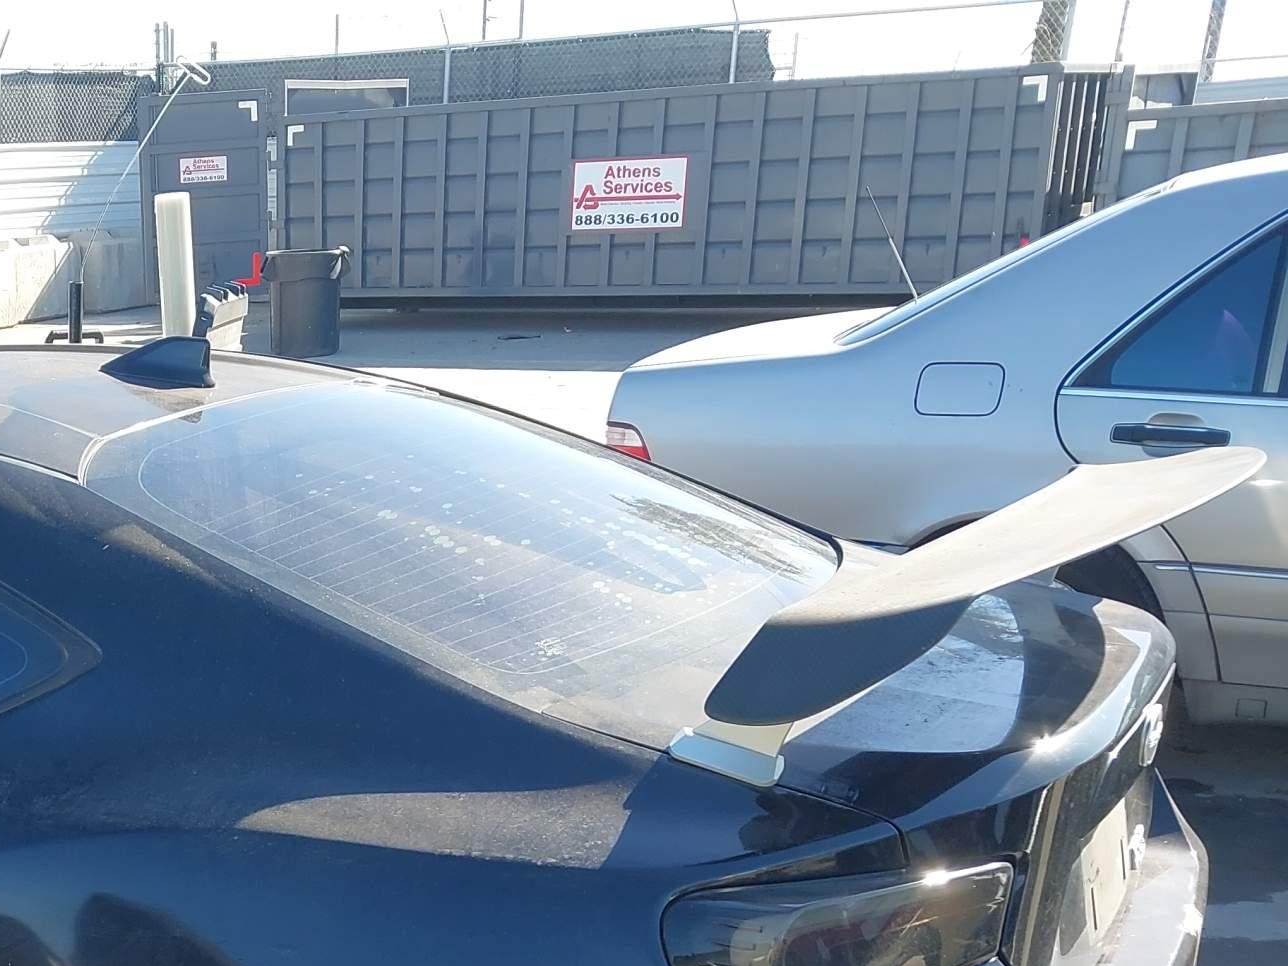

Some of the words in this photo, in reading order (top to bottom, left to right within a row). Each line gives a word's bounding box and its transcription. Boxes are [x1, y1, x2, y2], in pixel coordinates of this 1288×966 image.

[604, 165, 661, 179] Athens
[603, 179, 673, 195] Services
[574, 211, 680, 226] 888/336-6100
